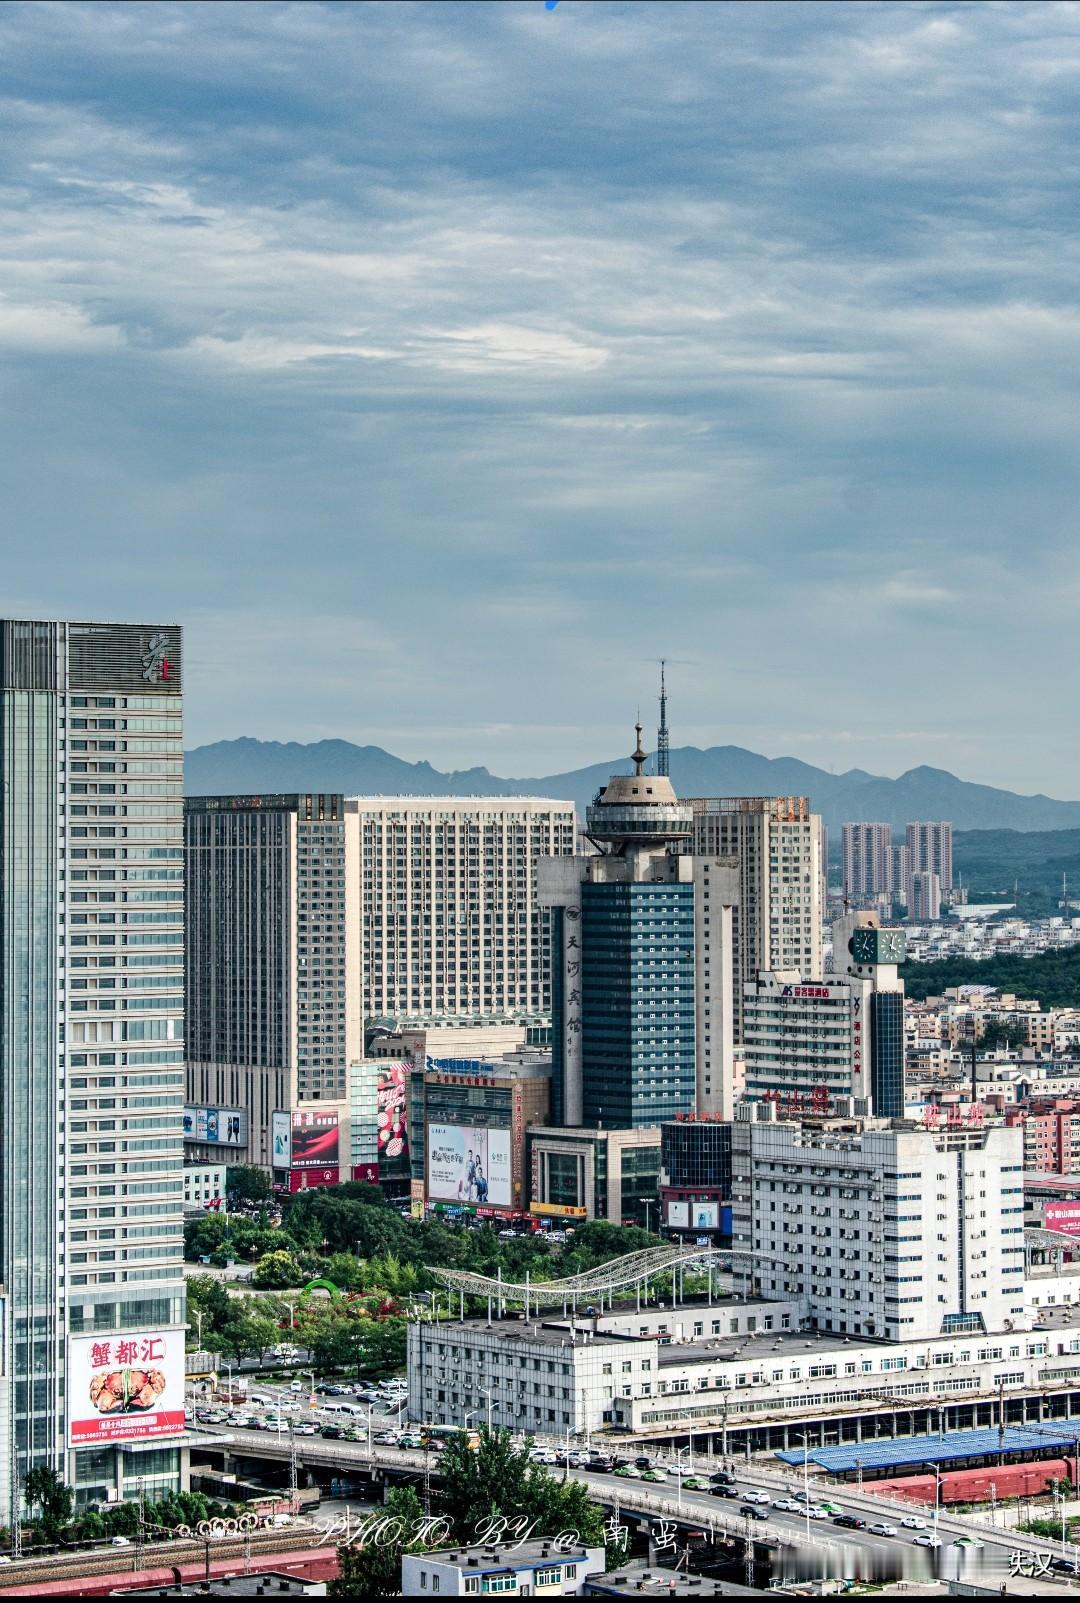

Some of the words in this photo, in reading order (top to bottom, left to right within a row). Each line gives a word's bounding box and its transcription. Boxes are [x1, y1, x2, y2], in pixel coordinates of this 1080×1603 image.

[567, 936, 580, 1033] 天河宾馆
[91, 1338, 164, 1368] 蟹都汇
